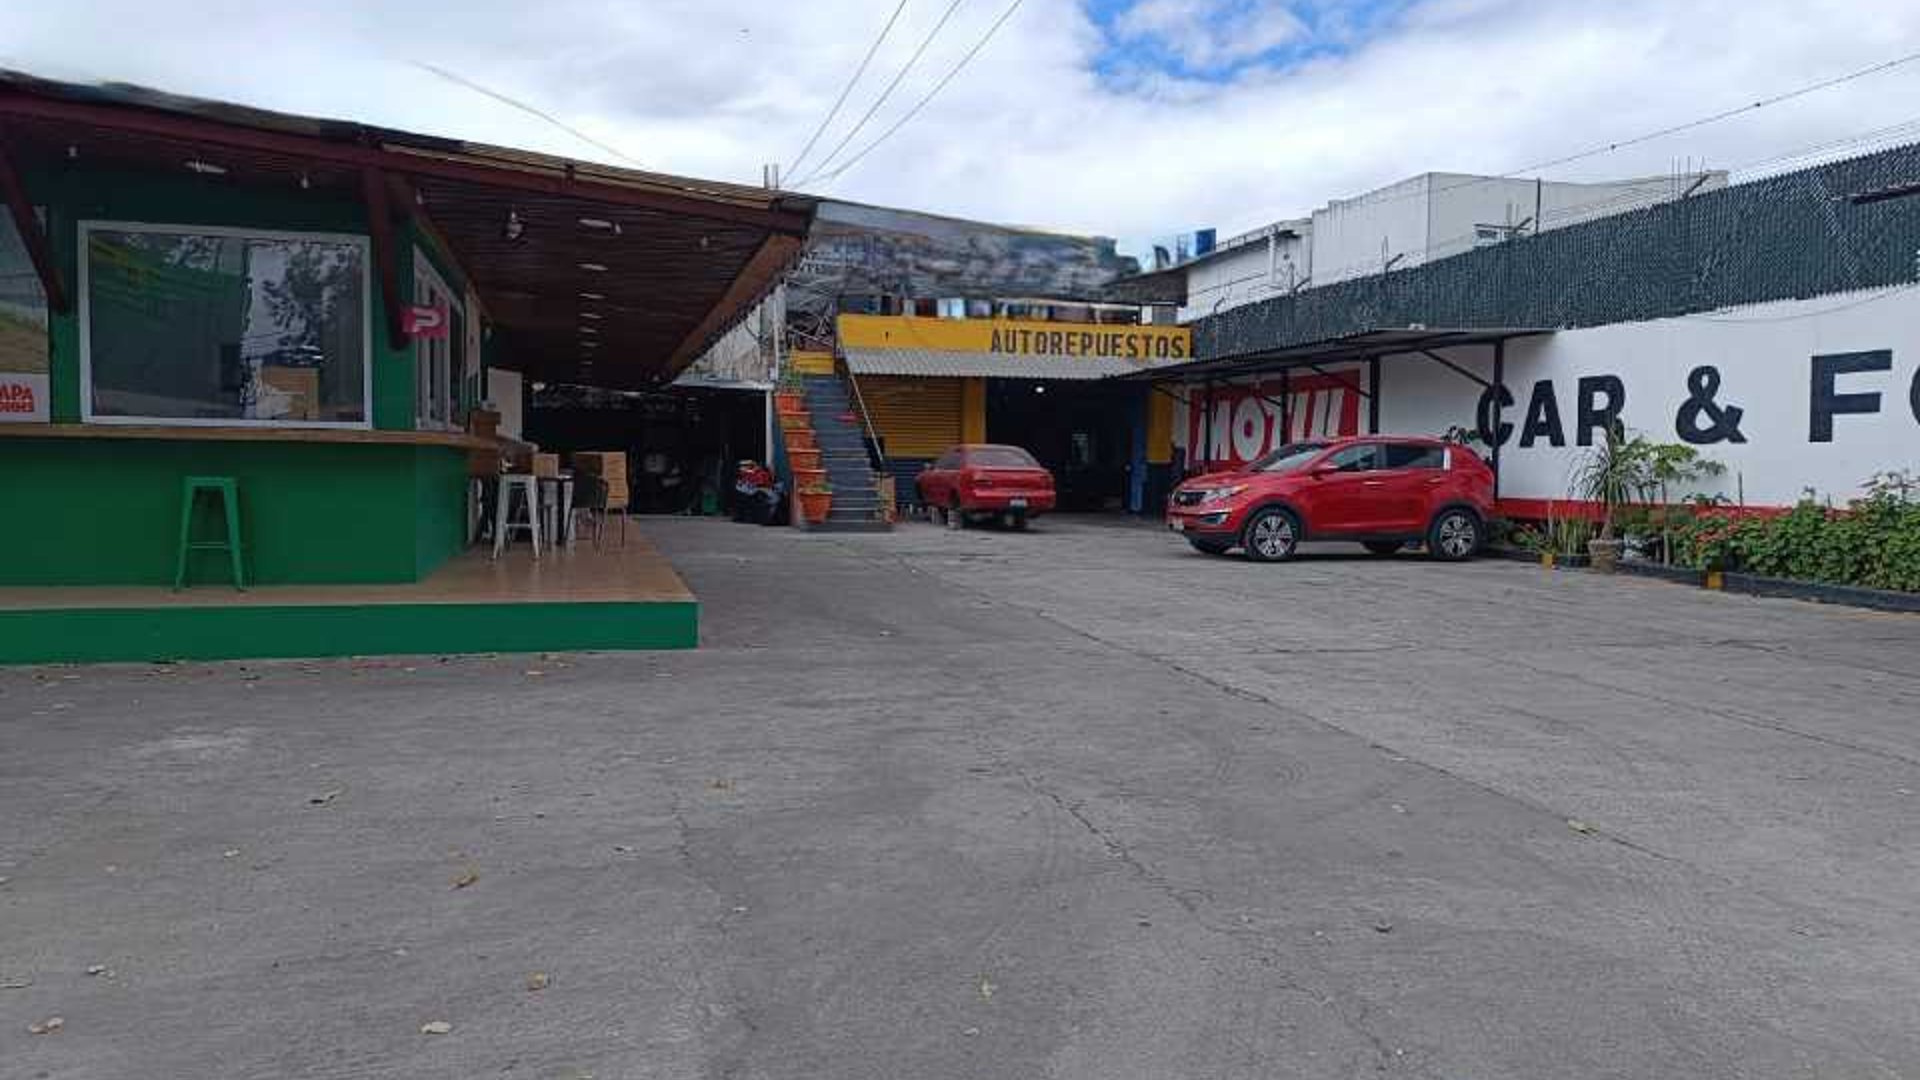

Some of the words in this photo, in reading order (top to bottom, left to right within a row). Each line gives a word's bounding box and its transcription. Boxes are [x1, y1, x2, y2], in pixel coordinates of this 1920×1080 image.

[991, 328, 1185, 358] AUTOREPUESTOS
[1476, 374, 1625, 448] CAR
[1808, 349, 1920, 443] F
